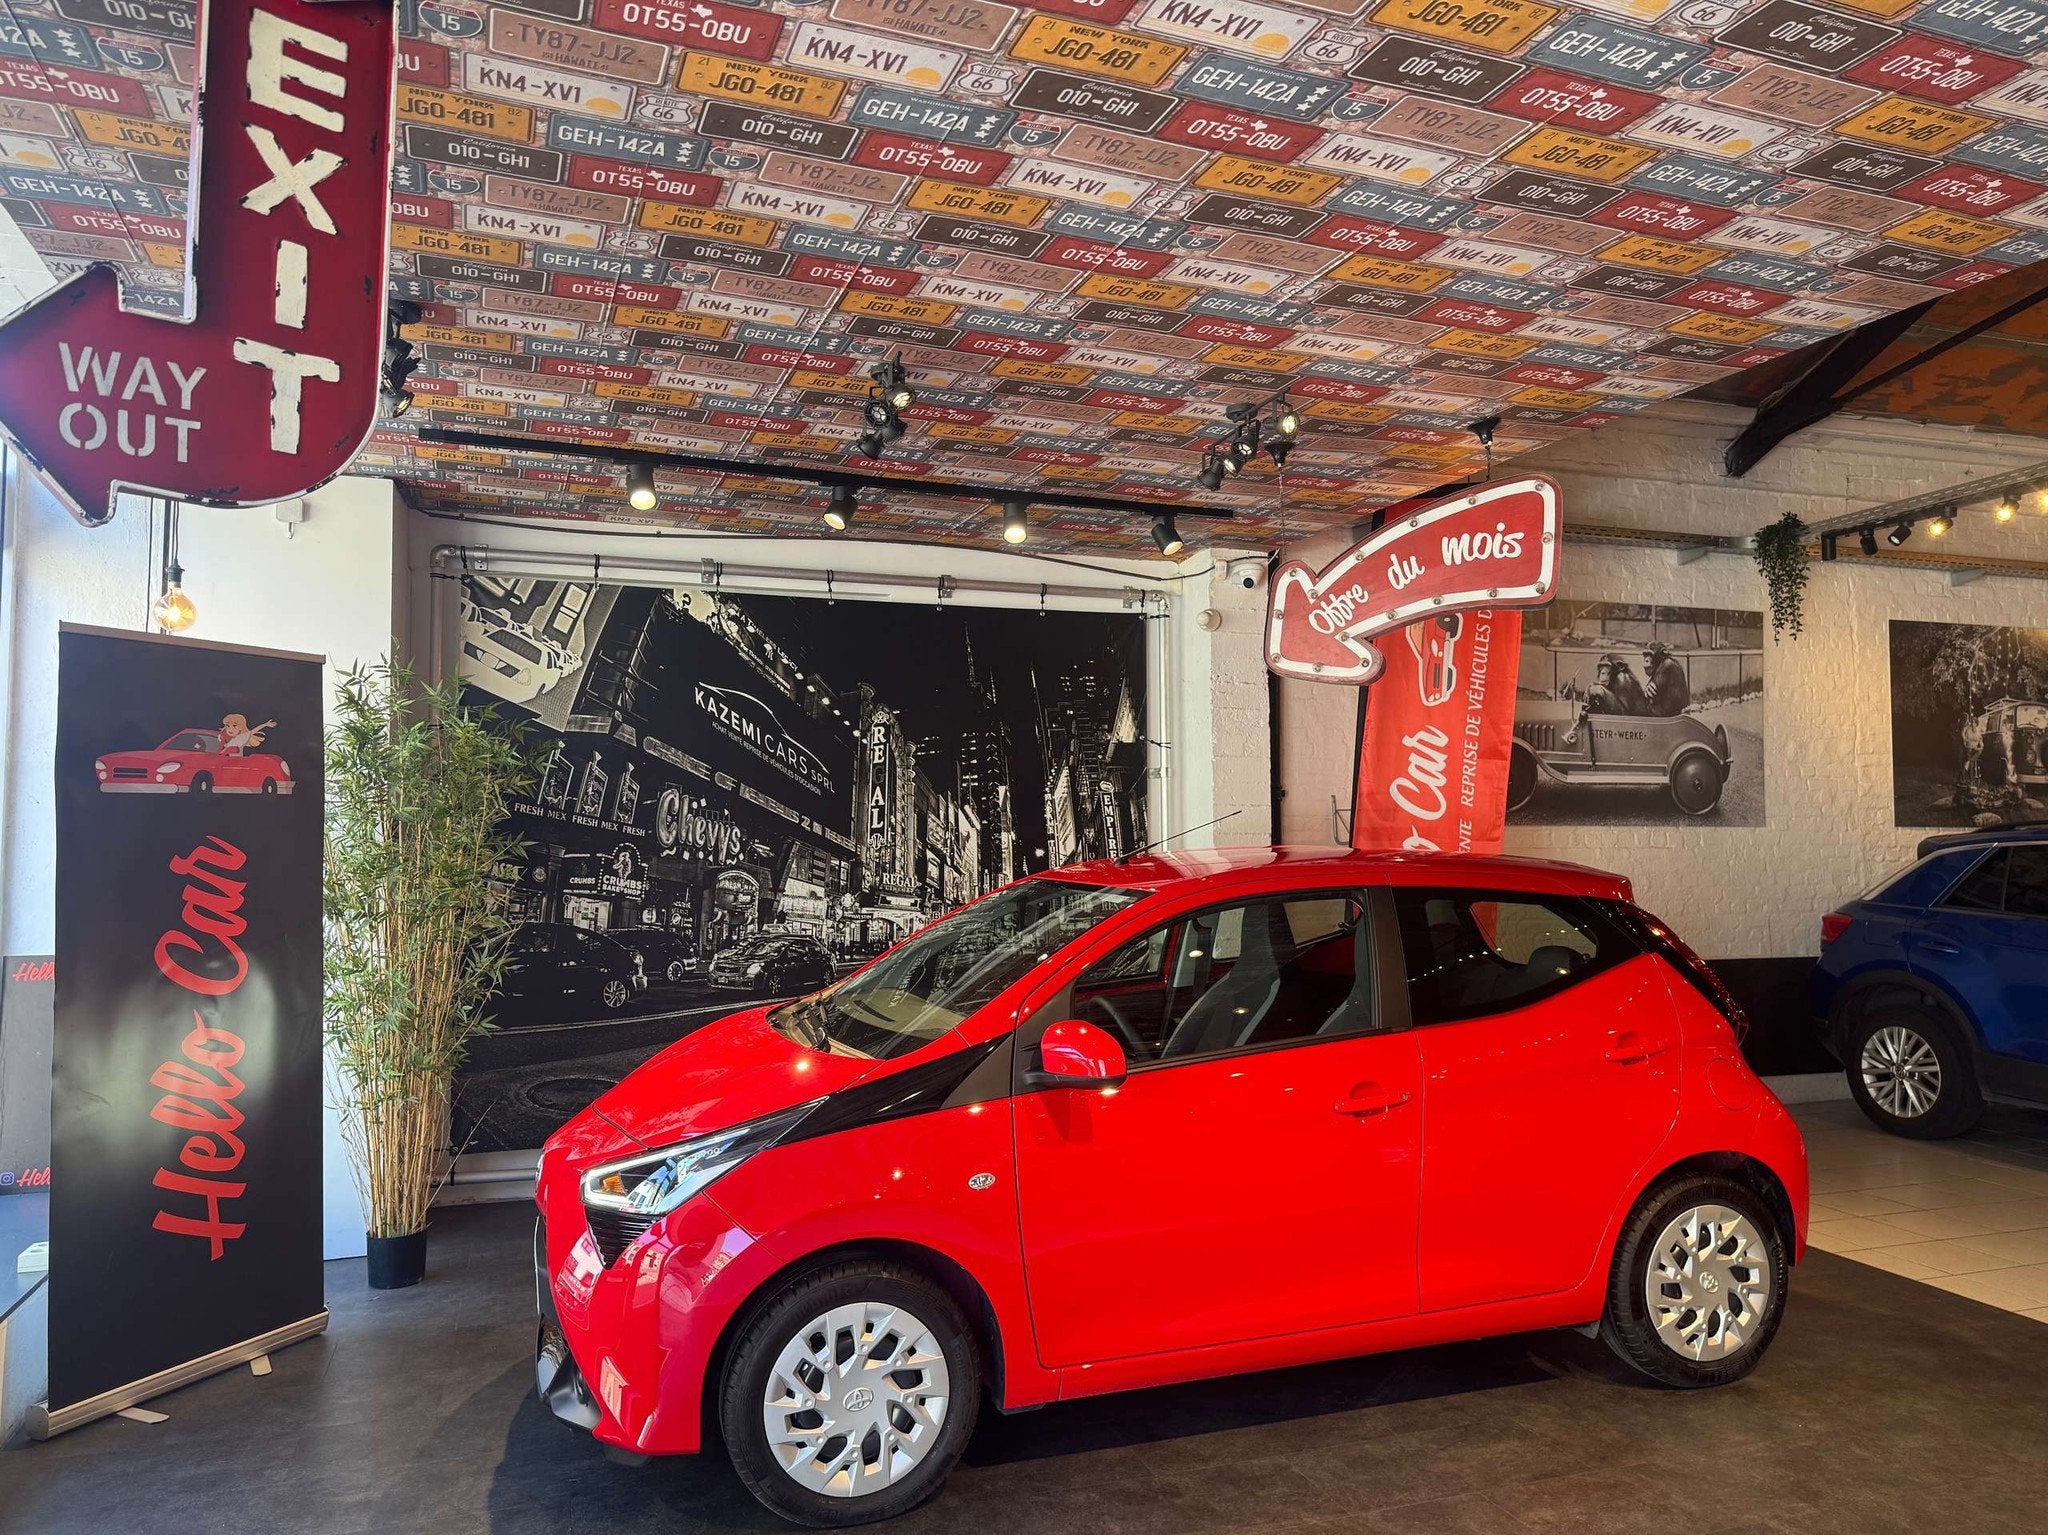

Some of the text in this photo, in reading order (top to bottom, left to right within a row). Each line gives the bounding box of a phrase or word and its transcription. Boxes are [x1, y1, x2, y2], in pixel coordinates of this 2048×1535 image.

[440, 15, 459, 33] 15
[1688, 7, 1724, 22] 66
[119, 48, 143, 65] 15
[1314, 44, 1344, 58] 66
[1546, 30, 1656, 70] GEH-142A
[970, 78, 996, 90] 66
[1190, 66, 1297, 102] GEH-142A
[1562, 82, 1591, 93] TEXAS
[1686, 68, 1722, 84] 15
[863, 97, 967, 131] GEH-142A
[1223, 113, 1250, 123] TEXAS
[1339, 100, 1369, 115] 15
[558, 124, 663, 156] GEH-142A
[909, 141, 935, 150] TEXAS
[1020, 129, 1044, 143] 15
[618, 165, 642, 174] TEXAS
[722, 155, 742, 168] 15
[445, 178, 460, 190] 15
[1646, 164, 1737, 192] GEH-142A
[1341, 190, 1431, 216] GEH-142A
[233, 8, 348, 455] EXIT
[1058, 212, 1146, 237] GEH-142A
[792, 233, 879, 256] GEH-142A
[542, 251, 630, 273] GEH-142A
[1716, 261, 1794, 281] GEH-142A
[58, 341, 208, 411] WAY
[59, 402, 201, 463] OUT
[1308, 522, 1525, 635] Offre du mois
[1466, 622, 1490, 712] VÉHICULES
[1465, 714, 1482, 738] DE
[695, 687, 835, 793] KAZEMI CARS SPRL
[871, 726, 886, 829] REGAL
[1389, 724, 1449, 821] Car
[1461, 740, 1479, 808] REPRISE
[514, 803, 646, 837] FRESH MEX FRESH MEX FRESH
[656, 788, 741, 865] Chevys
[1103, 794, 1118, 858] EMPIRE
[570, 876, 596, 885] CRUMBS
[602, 874, 642, 890] CRUMBS
[12, 961, 55, 982] Hell
[150, 835, 248, 1261] Hello Car
